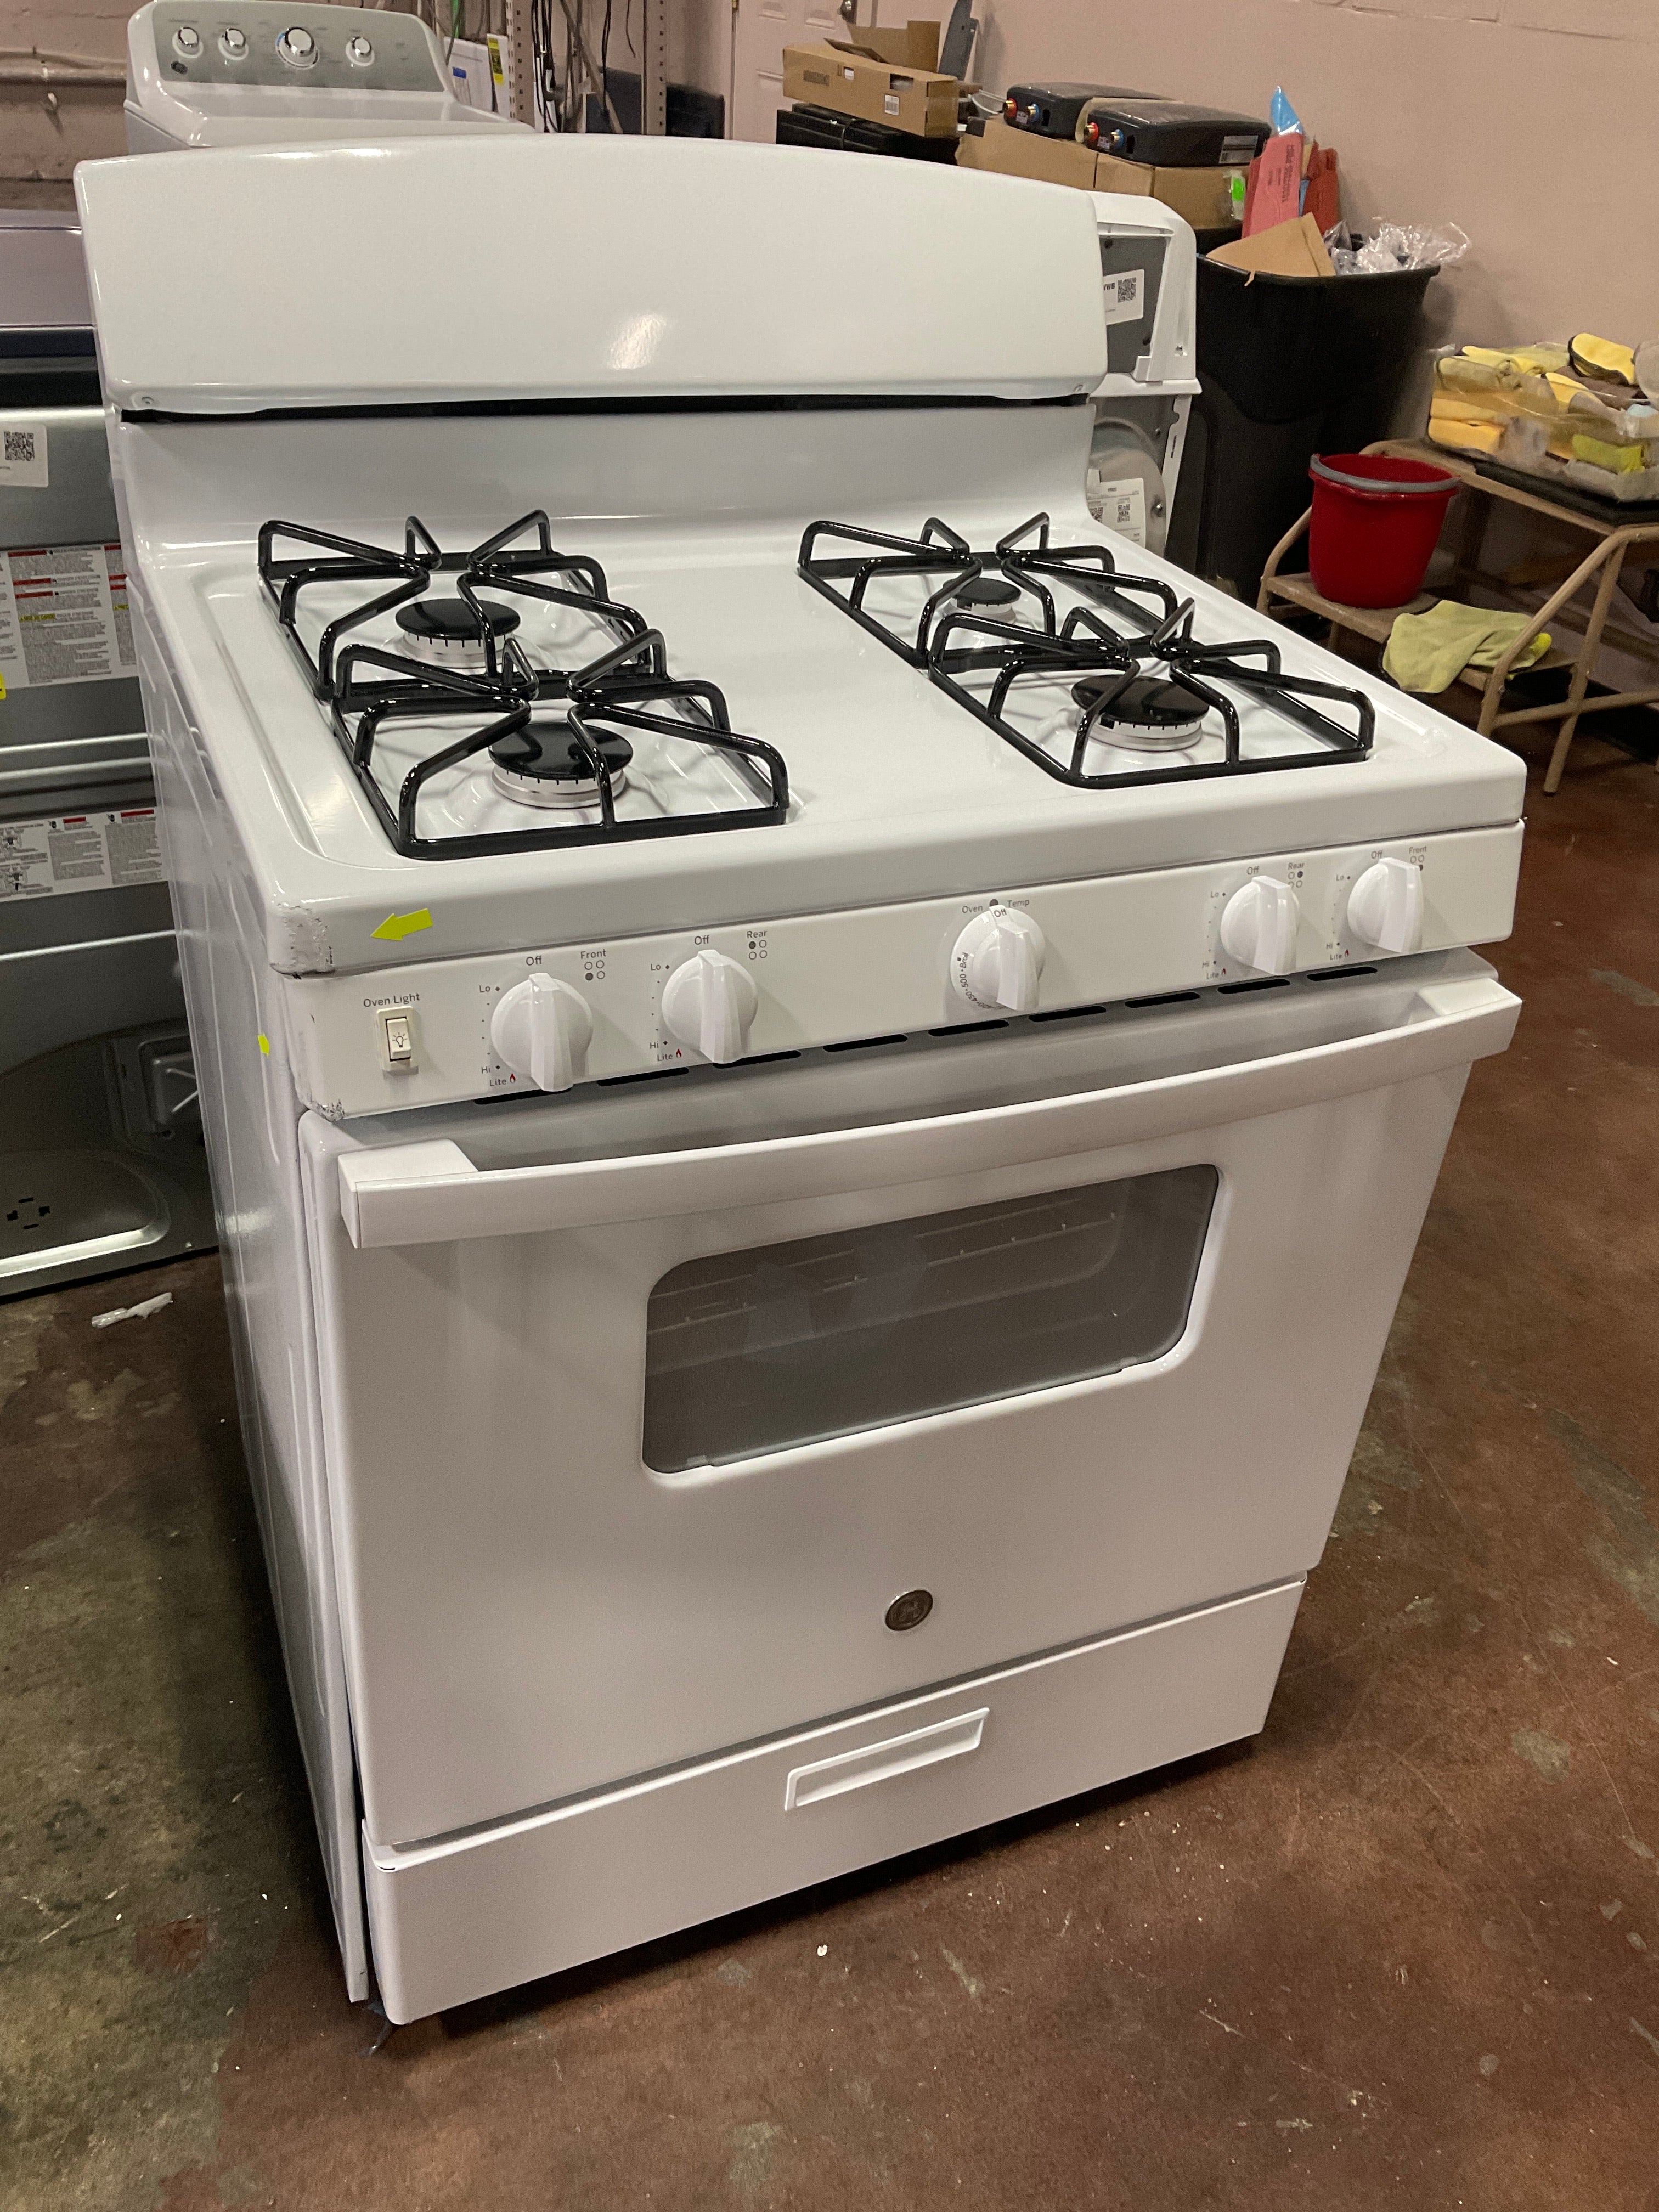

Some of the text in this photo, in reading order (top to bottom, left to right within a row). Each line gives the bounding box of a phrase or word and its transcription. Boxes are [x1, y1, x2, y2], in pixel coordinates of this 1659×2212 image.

[1371, 850, 1383, 859] Off
[1409, 846, 1427, 854] Front
[1246, 866, 1259, 875] Off
[1007, 899, 1030, 907] Temp
[994, 909, 1007, 917] Off
[747, 930, 768, 939] Rear
[694, 935, 710, 945] Off
[580, 949, 606, 959] Front
[526, 955, 542, 966] Off
[960, 974, 968, 988] 500
[479, 985, 490, 993] Lo
[363, 992, 420, 1007] Oven Light
[657, 1053, 673, 1062] Lite
[481, 1066, 490, 1074] Hi
[489, 1077, 507, 1087] Lite
